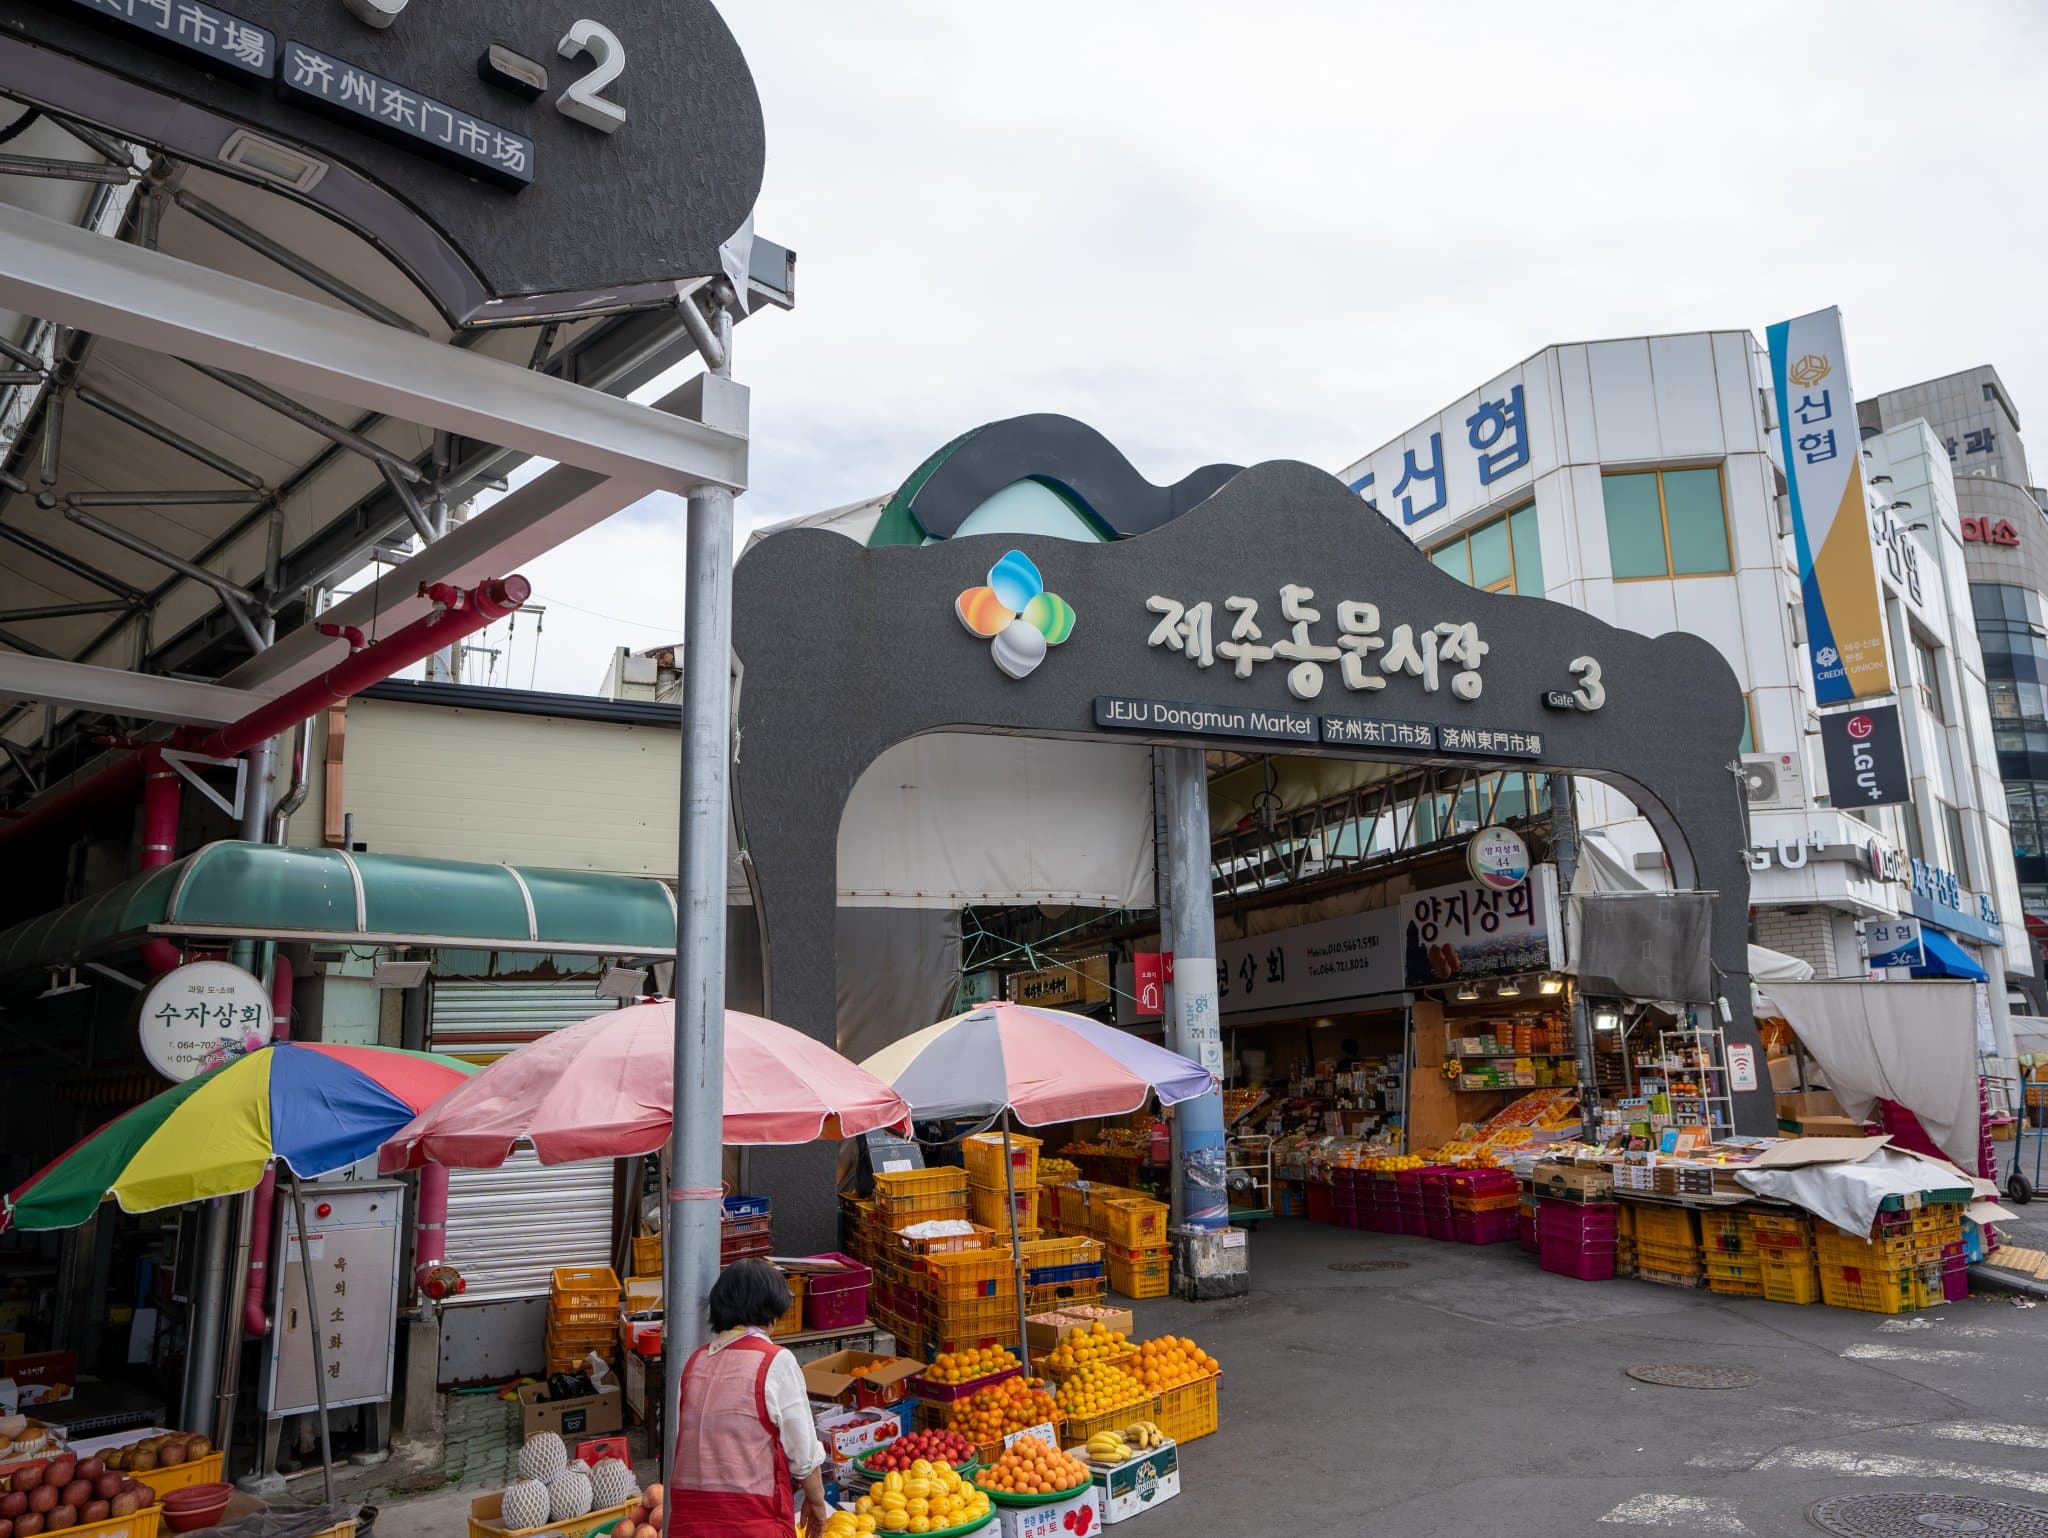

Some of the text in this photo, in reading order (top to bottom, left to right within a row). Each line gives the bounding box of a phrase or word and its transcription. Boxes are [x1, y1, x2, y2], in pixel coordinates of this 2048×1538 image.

[557, 19, 627, 134] 2
[292, 48, 527, 173] 济州东门市场
[1794, 389, 1838, 465] 신협
[1146, 584, 1490, 700] 제주동문시장
[1549, 655, 1606, 711] Gate 3
[1817, 661, 1883, 680] CREDIT UNION
[1106, 701, 1312, 735] JEJU Dongmun Market
[1326, 719, 1432, 746] 济州东门市场
[1414, 878, 1535, 942] 양지상회
[1872, 925, 1911, 941] 신협
[1887, 952, 1914, 966] 365
[187, 984, 204, 994] 과일
[155, 1002, 262, 1028] 수자상회
[328, 1257, 347, 1378] 옥외소화전
[1025, 1521, 1058, 1538] 토마토
